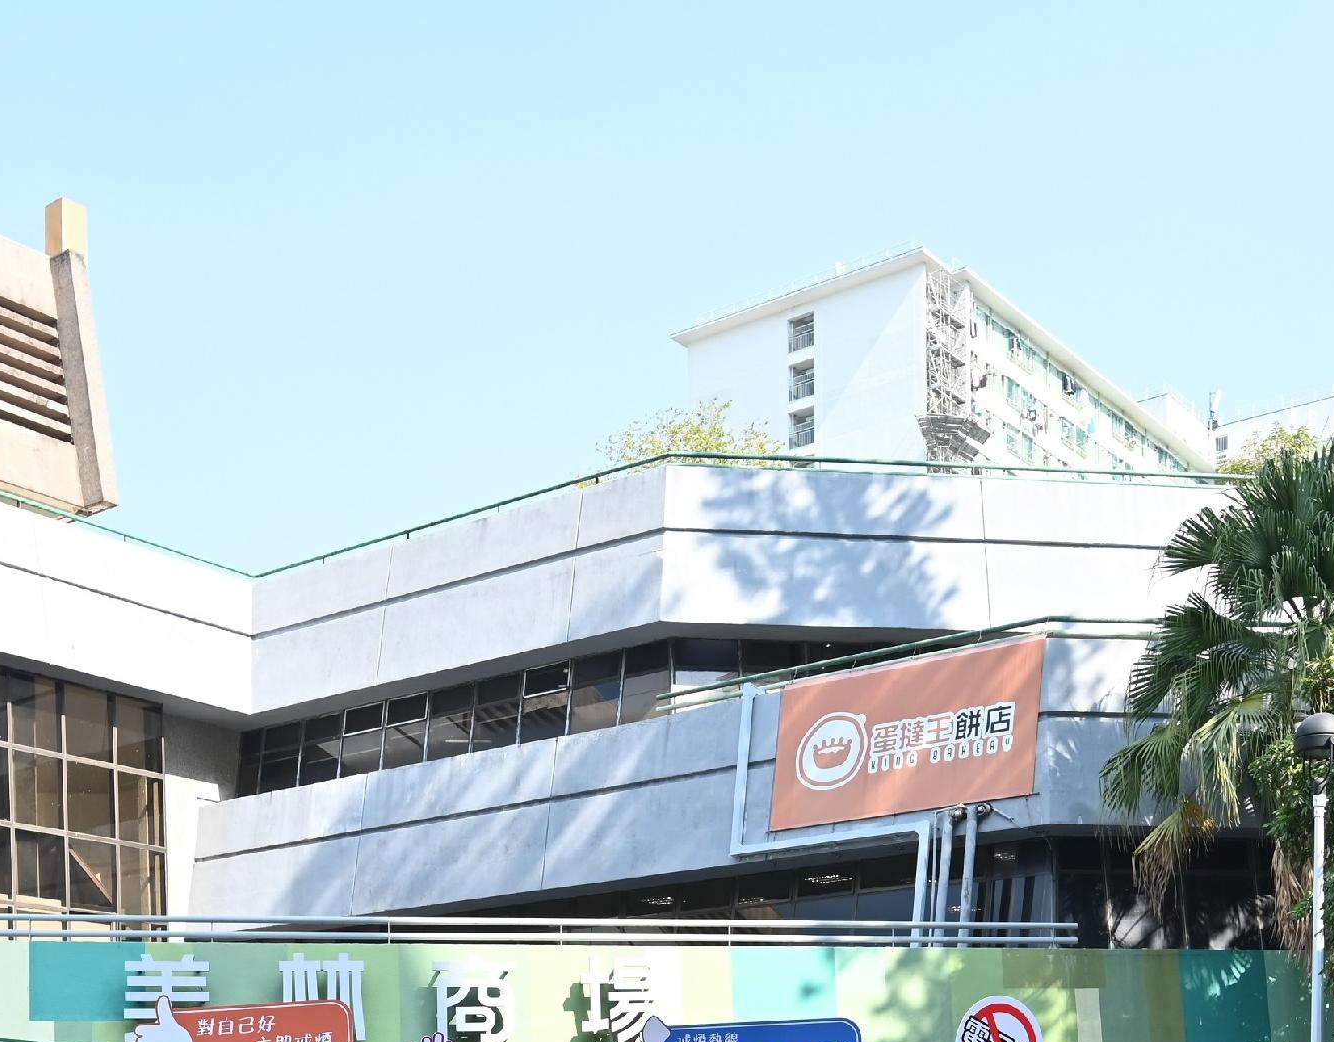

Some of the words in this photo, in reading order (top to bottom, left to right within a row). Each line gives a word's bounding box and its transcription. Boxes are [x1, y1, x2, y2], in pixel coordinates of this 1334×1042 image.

[872, 705, 1012, 755] 蛋撻王餅店
[870, 754, 915, 770] KING
[197, 1015, 276, 1036] 對自己好
